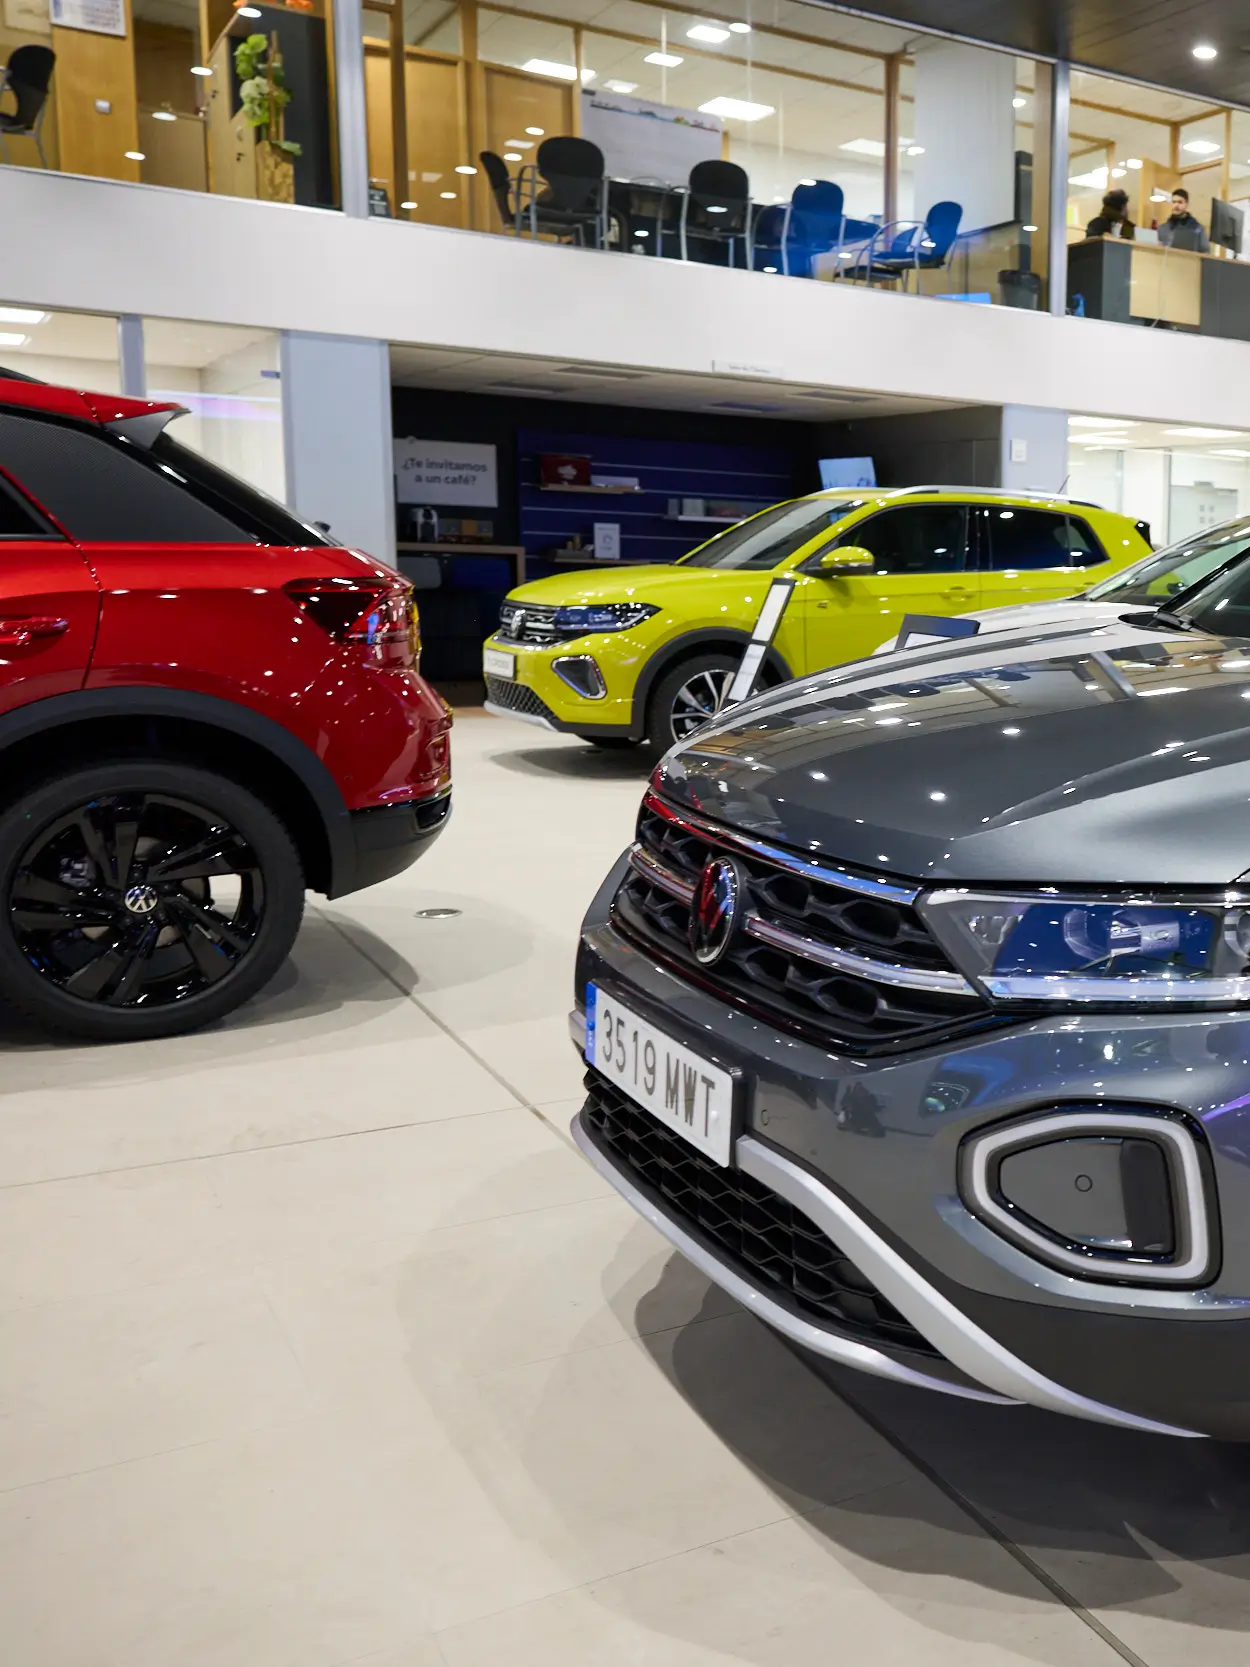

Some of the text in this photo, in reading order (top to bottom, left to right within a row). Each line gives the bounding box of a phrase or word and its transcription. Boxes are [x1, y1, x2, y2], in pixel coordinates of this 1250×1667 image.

[402, 457, 488, 472] ¿Te invitamos
[424, 475, 441, 483] un
[443, 474, 476, 486] café?
[603, 1009, 716, 1138] 3519 MWT
